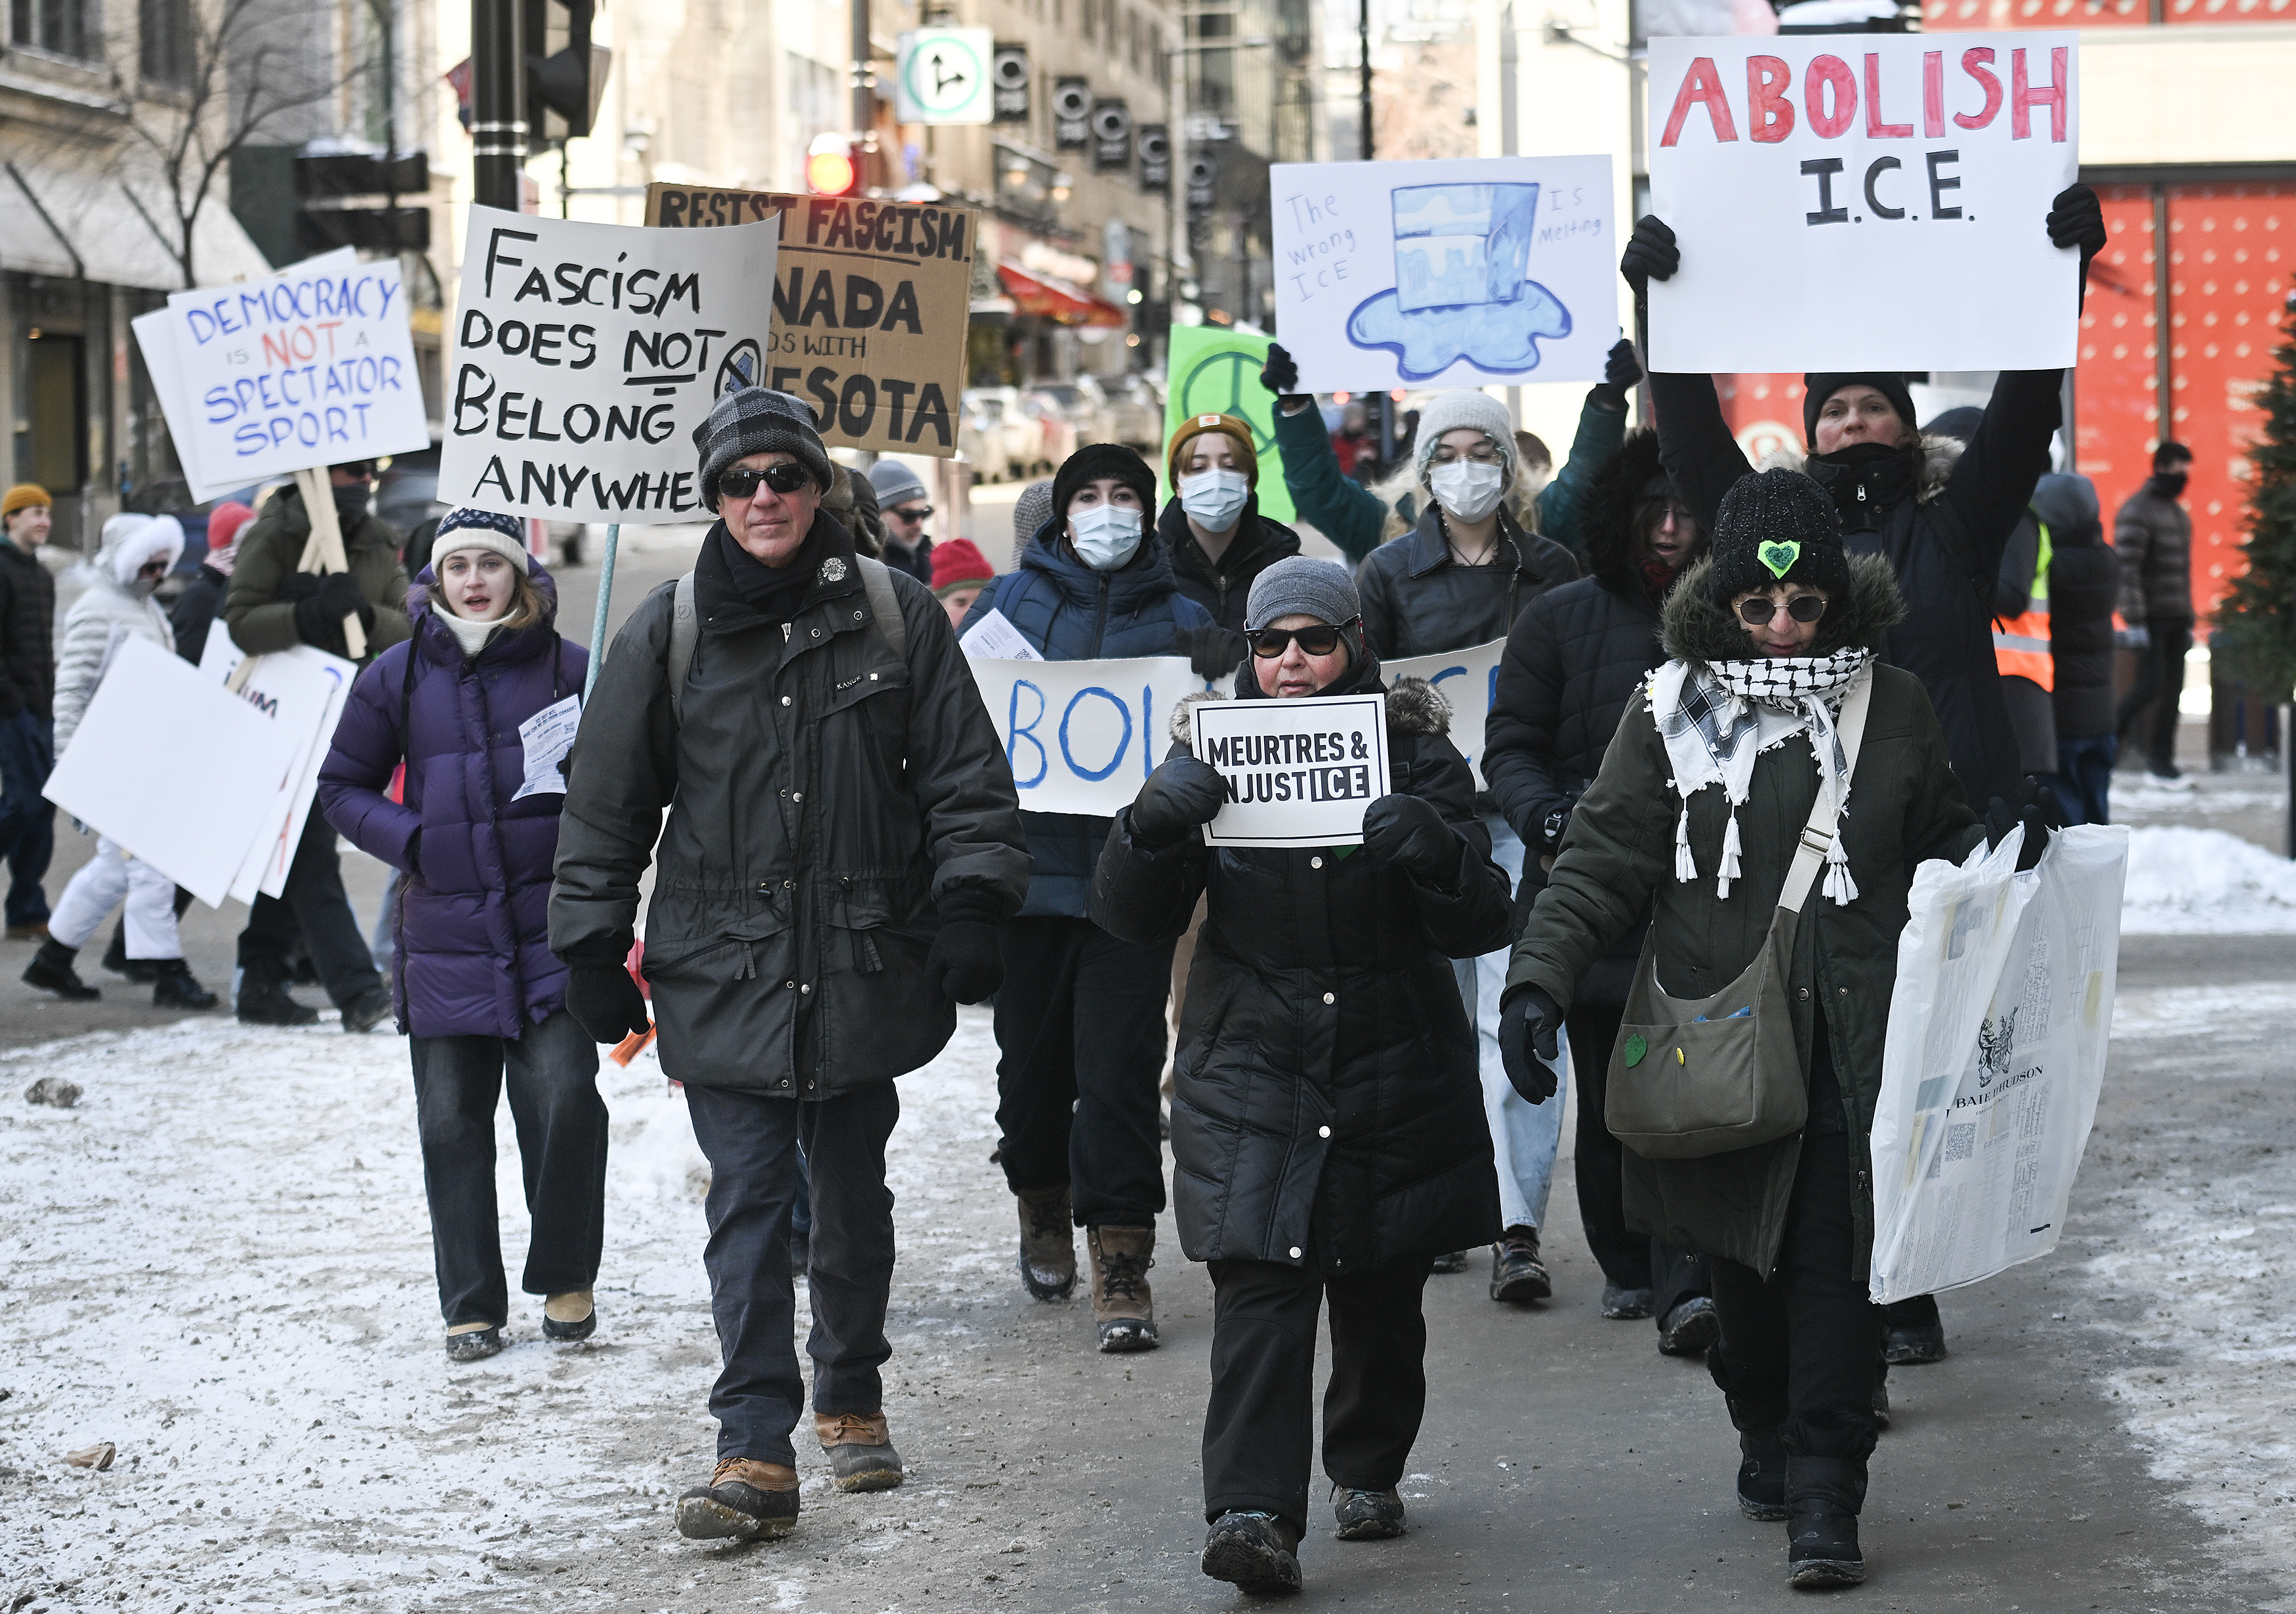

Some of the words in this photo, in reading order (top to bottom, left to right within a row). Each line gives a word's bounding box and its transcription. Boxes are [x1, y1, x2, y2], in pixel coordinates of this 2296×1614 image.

[1659, 47, 2068, 148] ABOLISH
[1284, 195, 1339, 234] The
[1549, 188, 1584, 212] IS
[1800, 150, 1975, 226] I.C.E.
[659, 190, 798, 241] RESIST
[806, 199, 971, 263] FASCISM.
[1287, 230, 1355, 266] wrong
[771, 267, 924, 335] NADA
[1289, 260, 1348, 302] ICE
[187, 276, 401, 346] DEMOCRACY
[227, 349, 249, 365] IS
[262, 321, 344, 368] NOT
[356, 332, 368, 348] A
[461, 310, 596, 370] DOES
[624, 329, 727, 373] NOT
[804, 335, 866, 358] WITH
[205, 356, 402, 424] SPECTATOR
[453, 363, 675, 445] BELONG
[766, 365, 953, 447] ESOTA
[234, 402, 373, 456] SPORT
[472, 454, 704, 514] ANYWHE
[836, 676, 861, 689] KANUK
[1208, 732, 1345, 767] MEURTRES
[1351, 731, 1369, 760] &
[1221, 765, 1367, 804] NJUSTICE
[1956, 1091, 1991, 1109] BAIE
